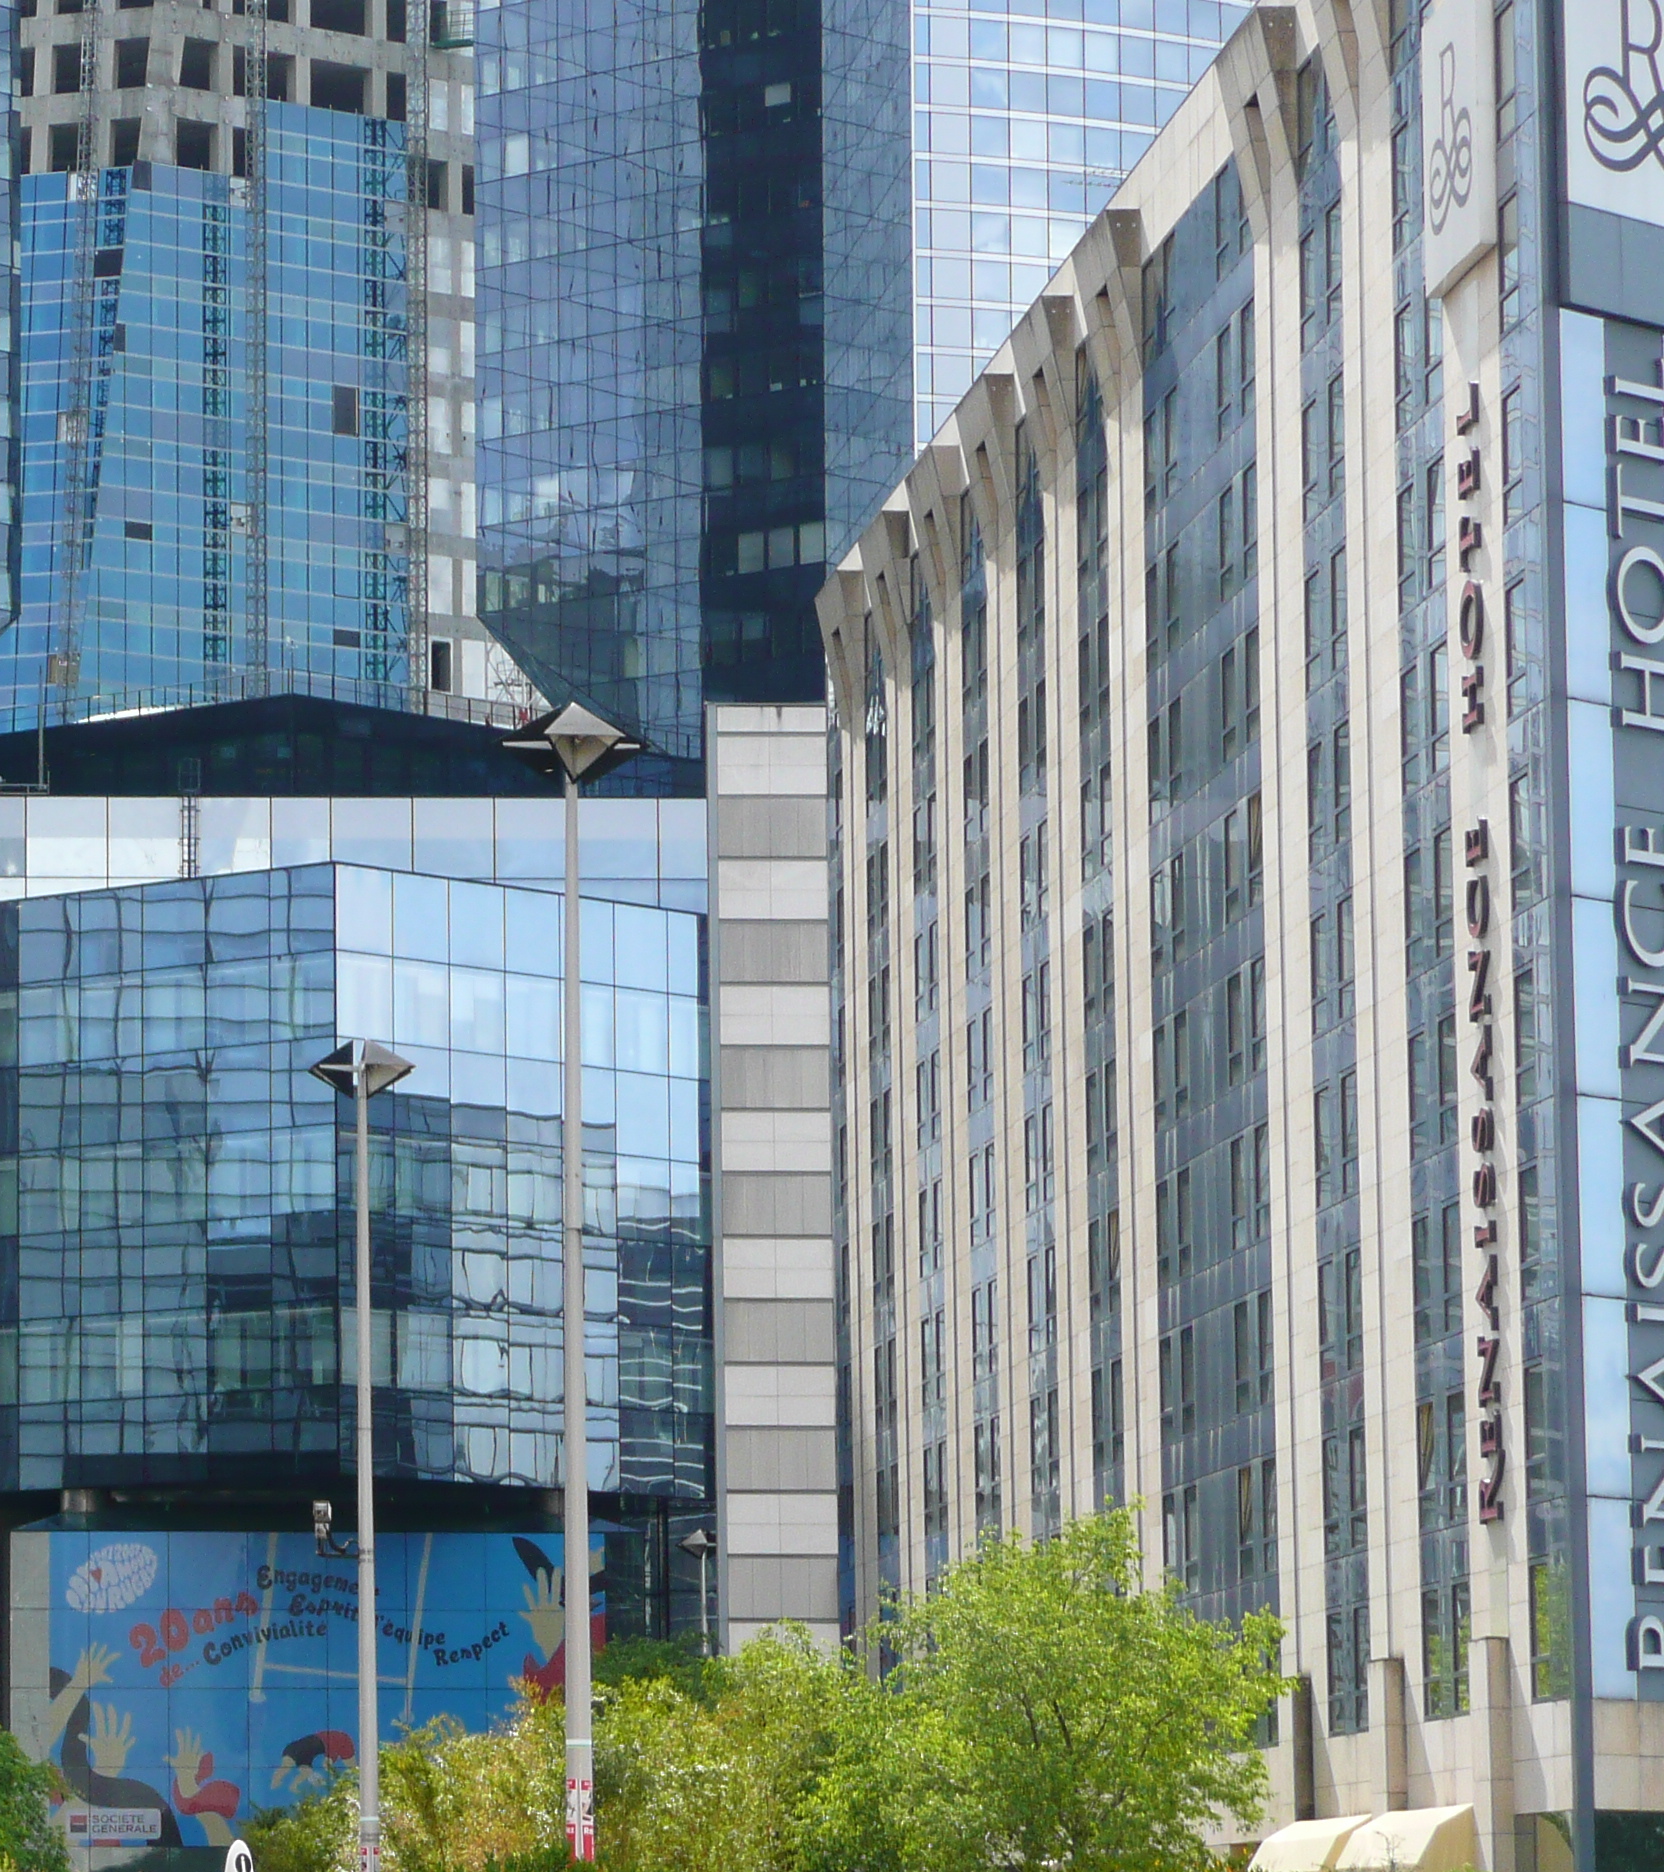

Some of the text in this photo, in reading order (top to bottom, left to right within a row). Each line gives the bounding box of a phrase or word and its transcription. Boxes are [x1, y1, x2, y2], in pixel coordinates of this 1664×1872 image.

[1456, 381, 1506, 1525] RENAISSANCE HOTEL
[256, 1564, 380, 1597] Engageme
[129, 1608, 190, 1668] 20
[203, 1619, 327, 1666] Convivialité
[374, 1614, 446, 1650] 'équipe
[433, 1620, 510, 1667] Respect
[91, 1814, 145, 1824] SOCIETE
[91, 1824, 157, 1834] GENERALE
